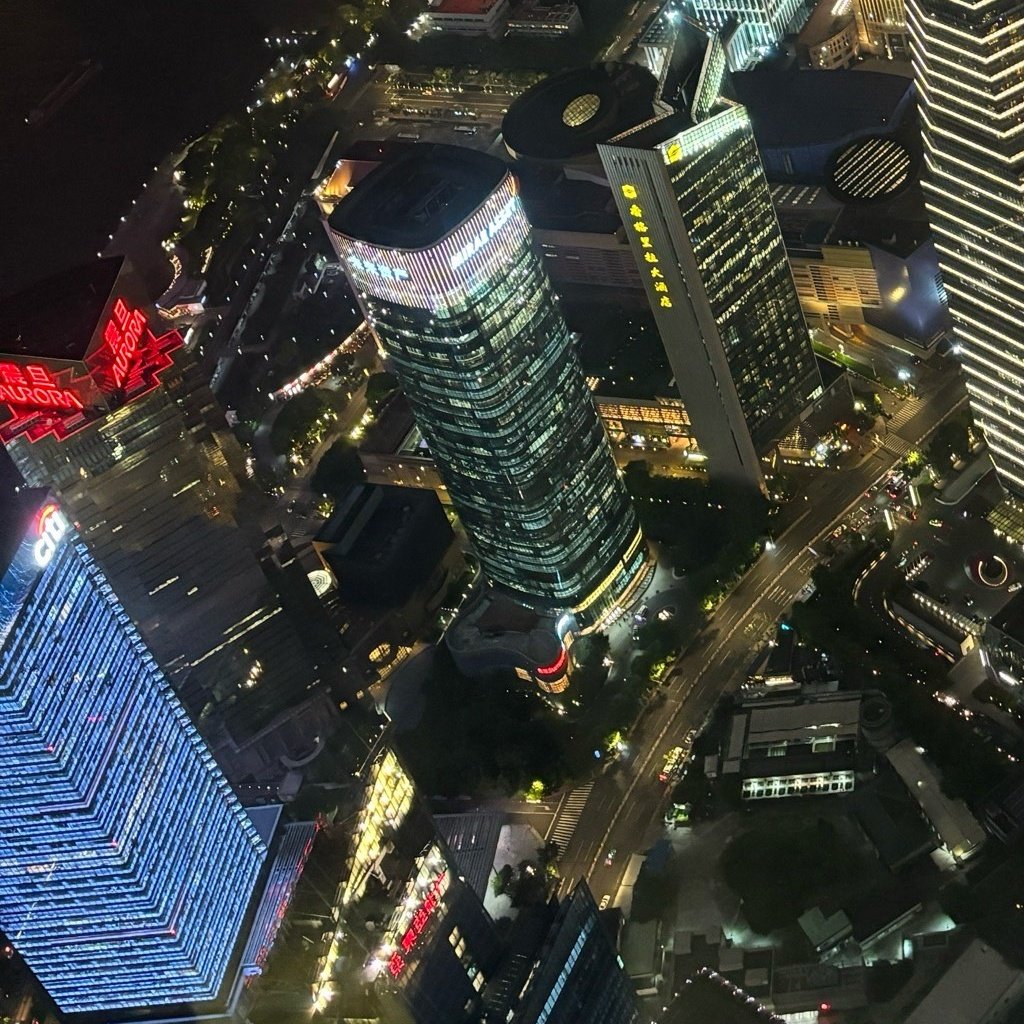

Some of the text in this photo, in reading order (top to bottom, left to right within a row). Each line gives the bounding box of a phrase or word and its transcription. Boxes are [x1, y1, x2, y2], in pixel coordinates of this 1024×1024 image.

[629, 204, 673, 308] 香格里拉大酒店
[104, 298, 132, 355] 震旦
[112, 309, 147, 388] AURORA
[0, 384, 84, 409] AURORA
[34, 510, 67, 568] citi
